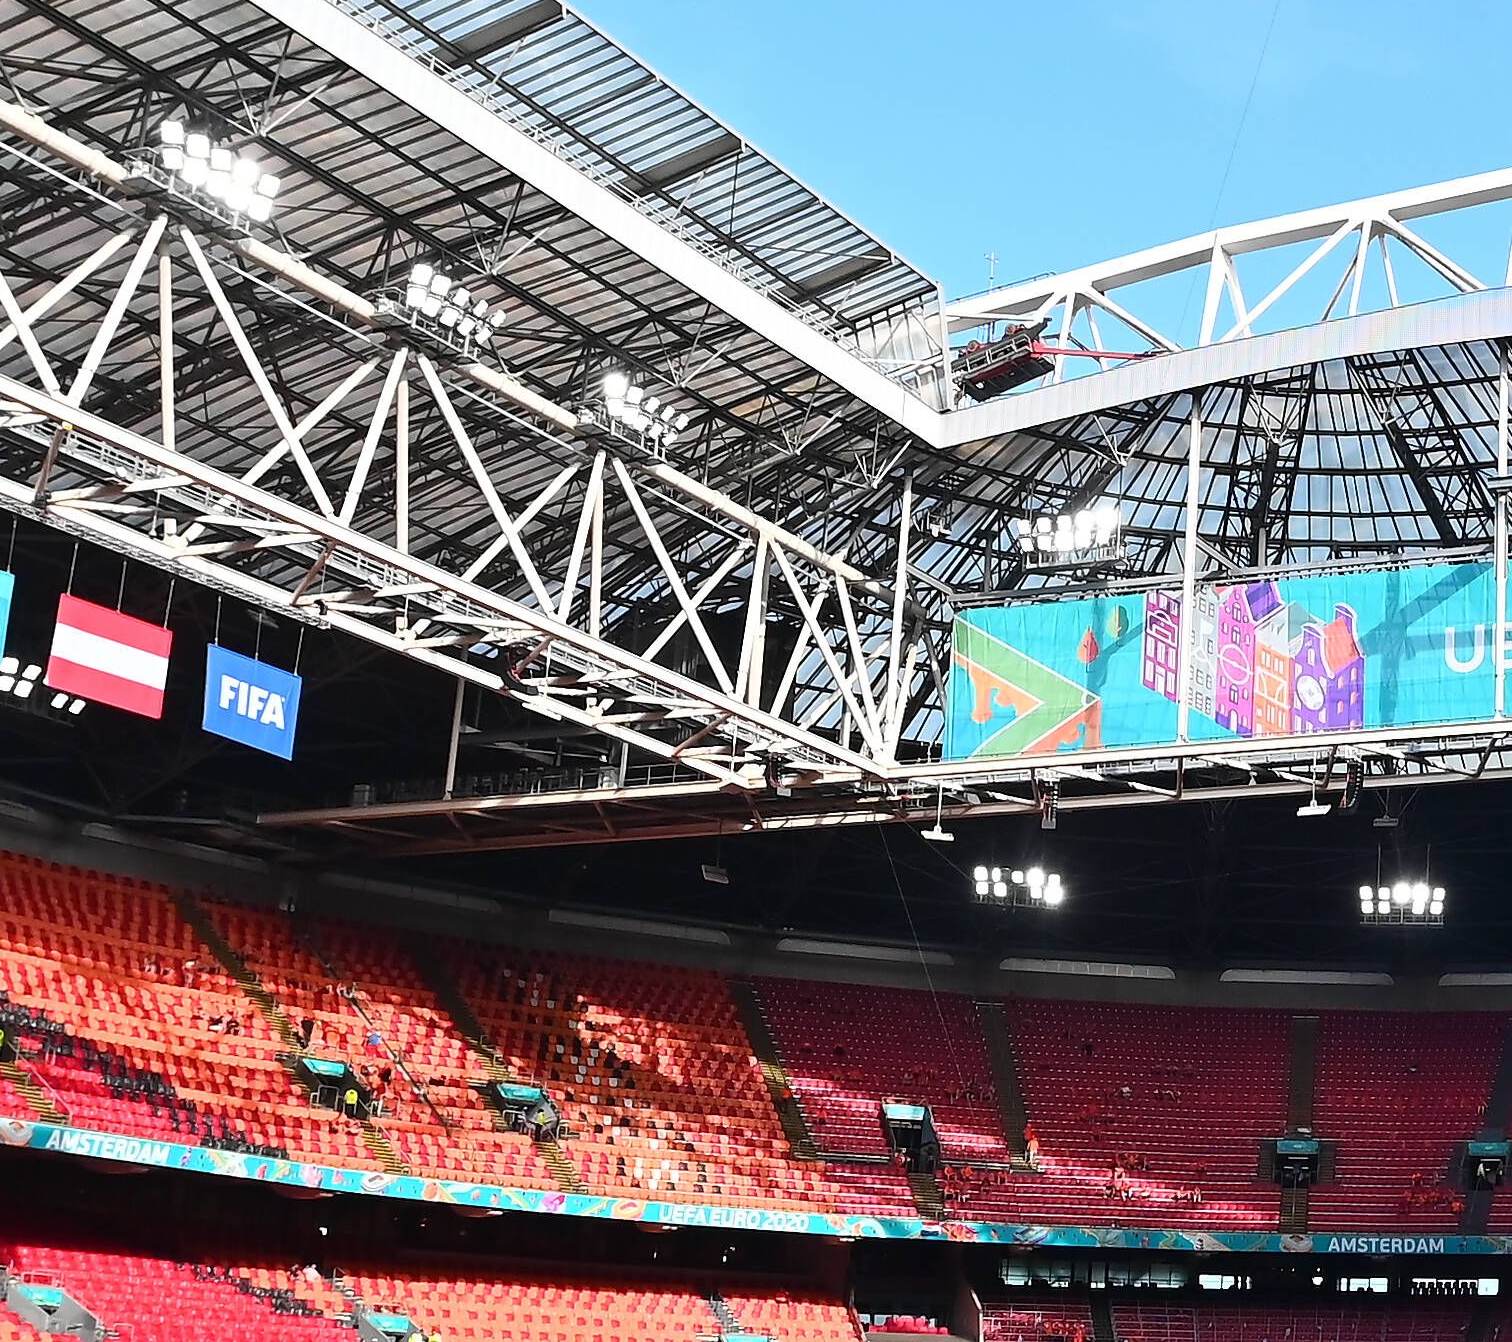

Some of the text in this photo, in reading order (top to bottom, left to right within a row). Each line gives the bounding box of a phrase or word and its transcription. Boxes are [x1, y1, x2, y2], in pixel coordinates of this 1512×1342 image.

[219, 674, 286, 730] FIFA
[45, 1129, 171, 1164] AMSTERDAM
[659, 1204, 809, 1232] UEFA EURO 2020
[1328, 1236, 1445, 1254] AMSTERDAM
